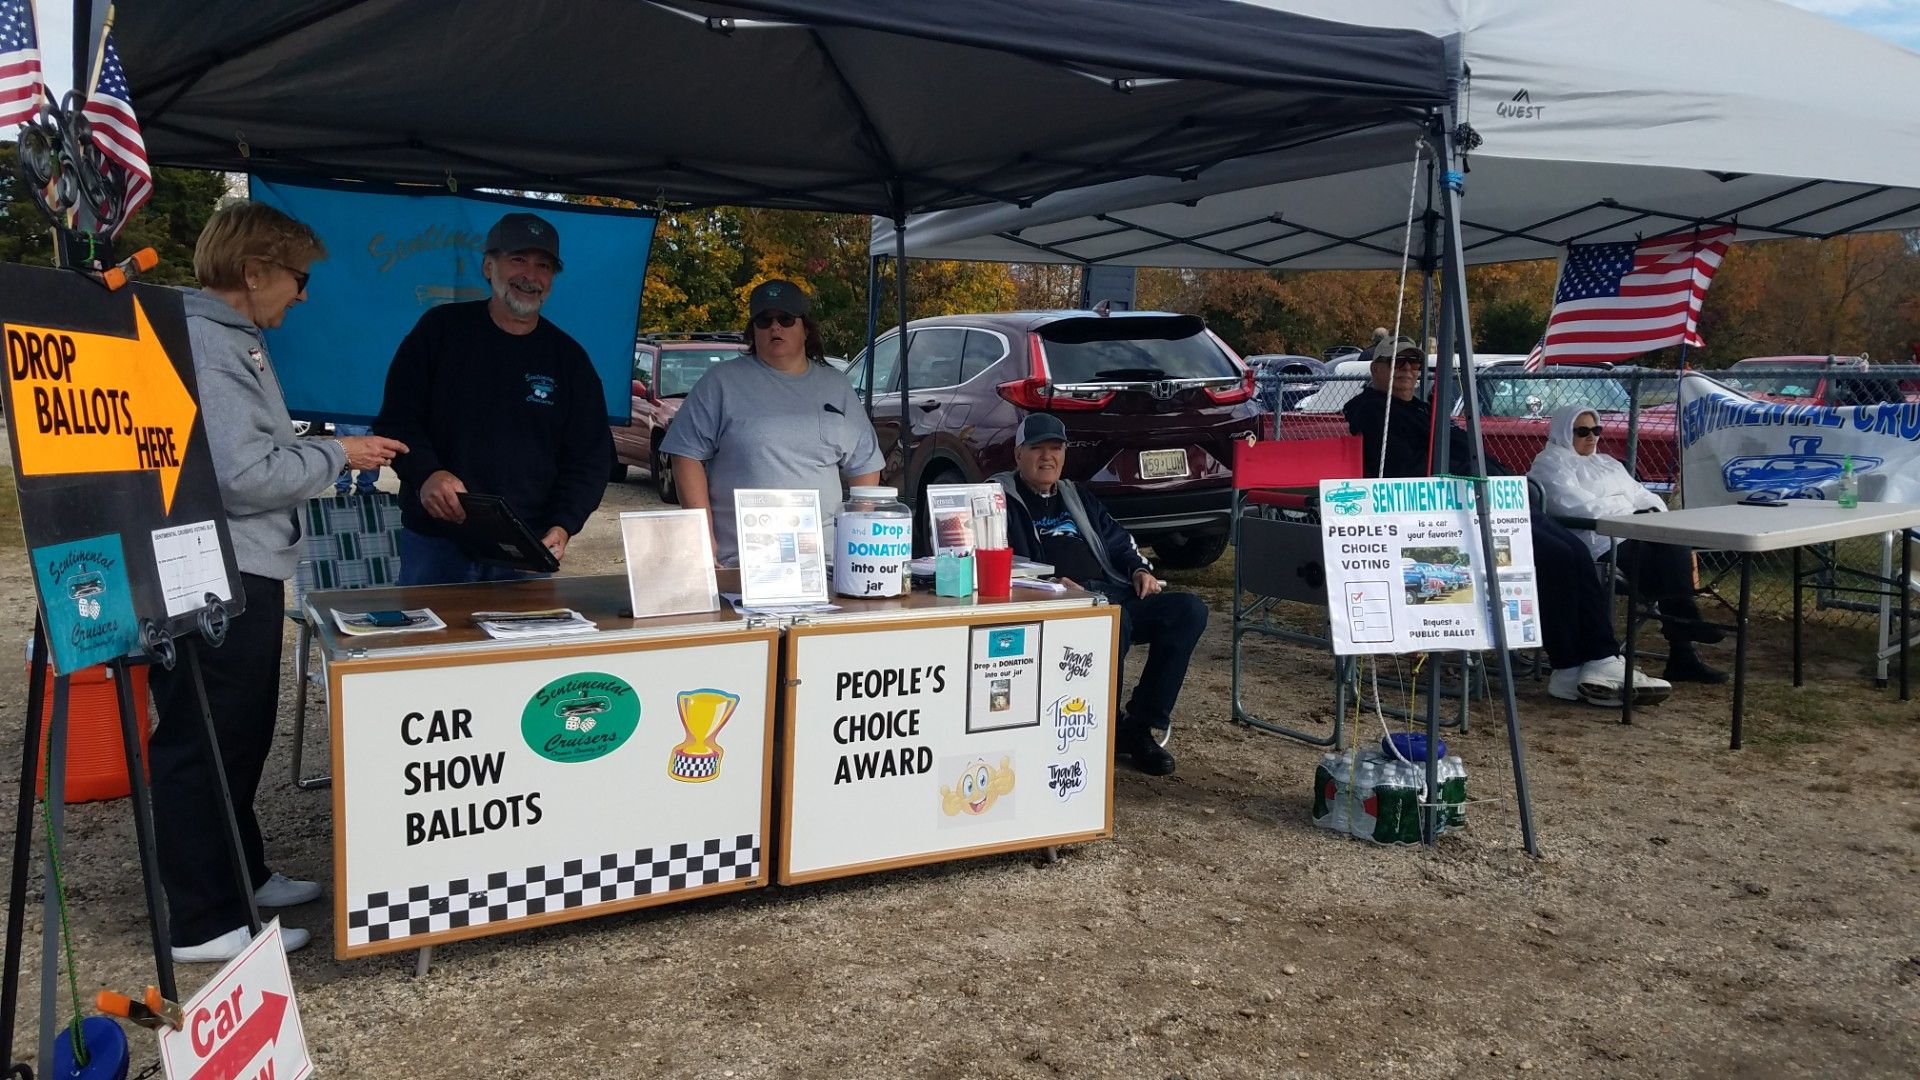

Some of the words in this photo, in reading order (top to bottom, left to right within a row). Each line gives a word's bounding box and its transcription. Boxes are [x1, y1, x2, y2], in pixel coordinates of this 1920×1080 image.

[1496, 102, 1545, 119] QUEST
[7, 329, 76, 383] DROP
[34, 386, 134, 437] BALLOTS
[135, 427, 180, 470] HERE
[1372, 480, 1463, 513] SENTIMENTAL
[1466, 480, 1525, 510] CISERS
[851, 528, 866, 536] and
[871, 522, 904, 539] Drop
[1328, 524, 1398, 538] PEOPLE'S
[1496, 517, 1529, 525] DONATION
[1407, 531, 1426, 542] your
[1428, 529, 1463, 539] favorite?
[1341, 543, 1388, 554] CHOICE
[49, 549, 115, 585] Sentimental
[851, 561, 875, 574] into
[879, 564, 899, 574] our
[1341, 559, 1391, 570] VOTING
[864, 580, 884, 595] jar
[71, 619, 119, 646] Cruisers
[1409, 630, 1440, 638] PUBLIC
[1443, 628, 1475, 637] BALLOT
[1423, 618, 1453, 628] Request
[973, 663, 990, 671] Drop
[999, 658, 1034, 668] DONATION
[1063, 646, 1094, 668] Thank
[985, 671, 998, 679] into
[1012, 668, 1023, 678] jar
[1065, 662, 1091, 681] you
[535, 680, 633, 707] Sentimental
[835, 664, 947, 702] PEOPLE'S
[1047, 694, 1095, 728] Thank
[400, 708, 474, 747] CAR
[833, 708, 920, 745] CHOICE
[544, 731, 617, 753] Cruisers
[1057, 726, 1086, 751] you
[403, 751, 506, 796] SHOW
[833, 746, 933, 786] AWARD
[1047, 761, 1082, 780] Thank
[1059, 776, 1082, 798] you
[405, 792, 543, 847] BALLOTS
[191, 984, 244, 1058] Car
